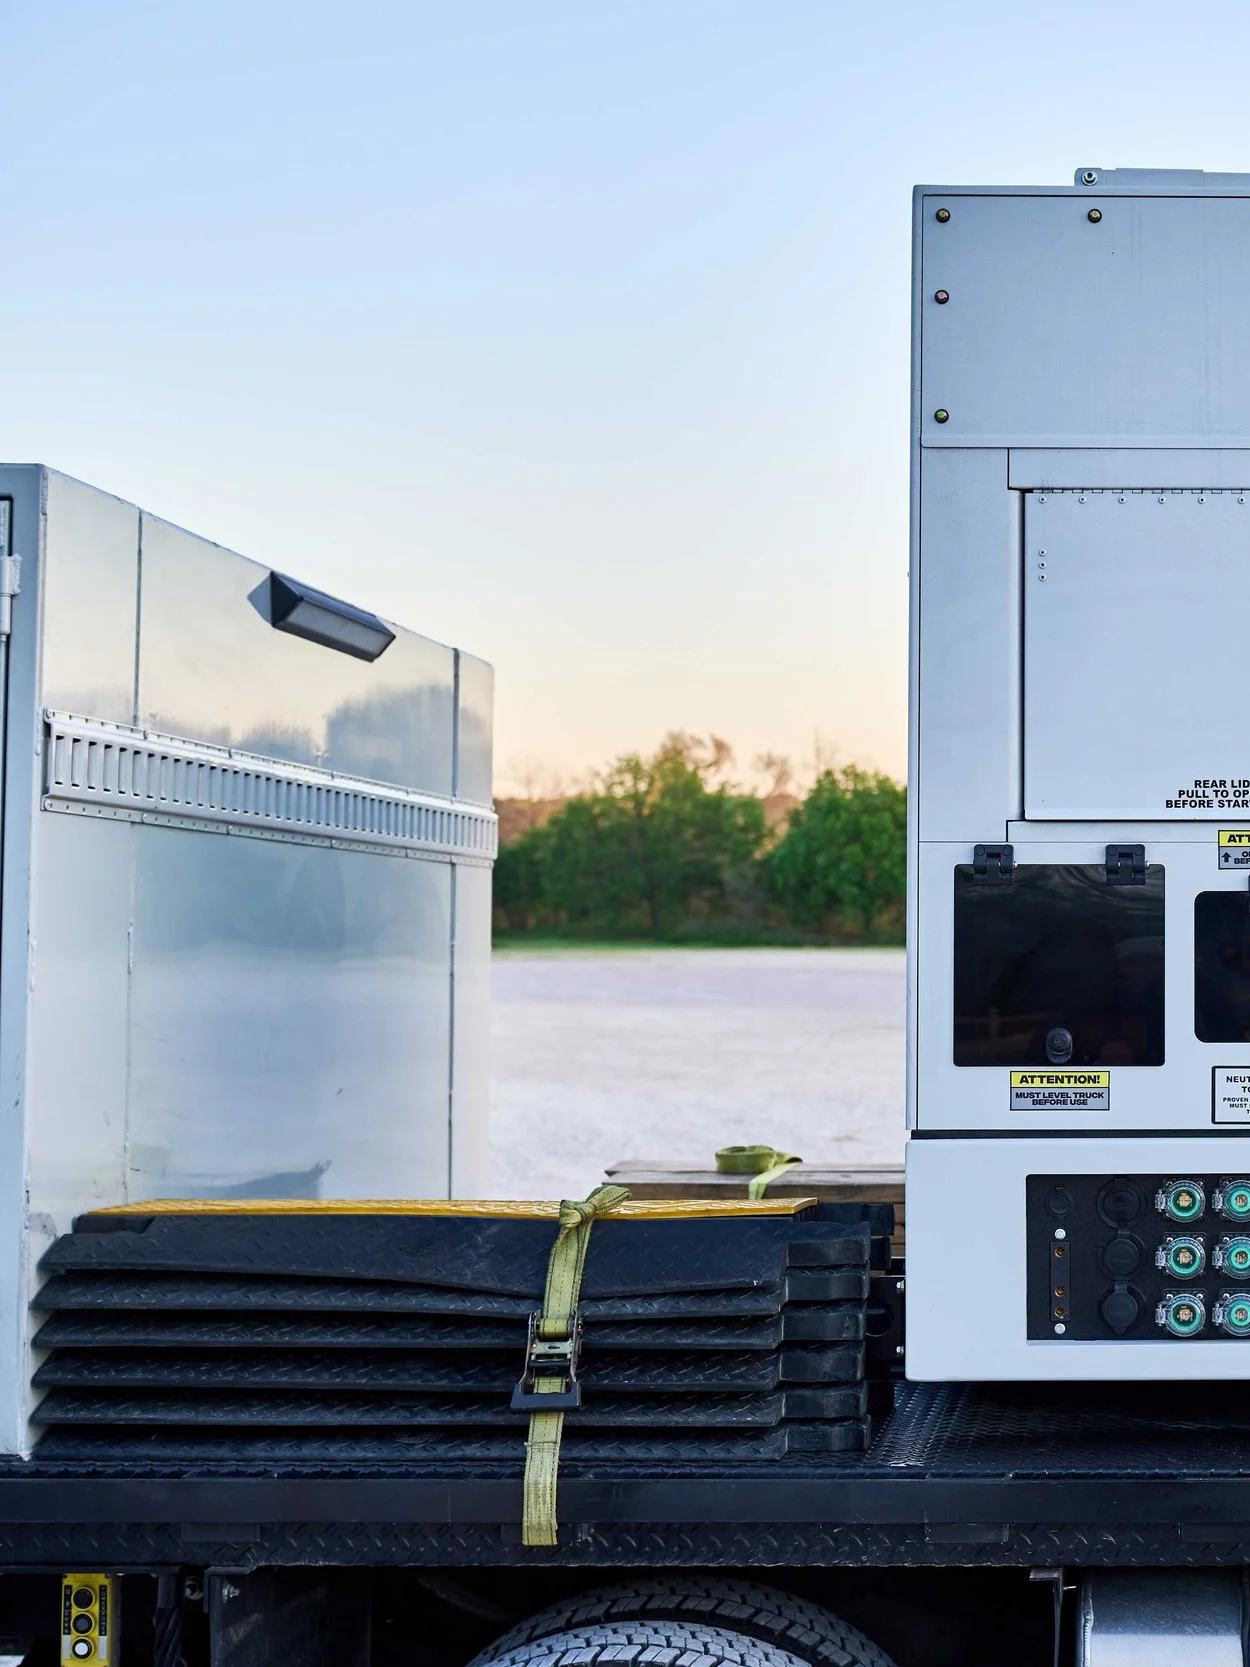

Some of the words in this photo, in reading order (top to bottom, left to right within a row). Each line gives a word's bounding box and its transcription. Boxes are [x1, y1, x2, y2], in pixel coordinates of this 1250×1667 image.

[1194, 779, 1227, 788] REAR
[1231, 779, 1250, 788] LID
[1178, 789, 1210, 798] PULL
[1213, 789, 1229, 798] TO
[1166, 799, 1214, 808] BEFORE
[1019, 1074, 1100, 1084] ATTENTION!
